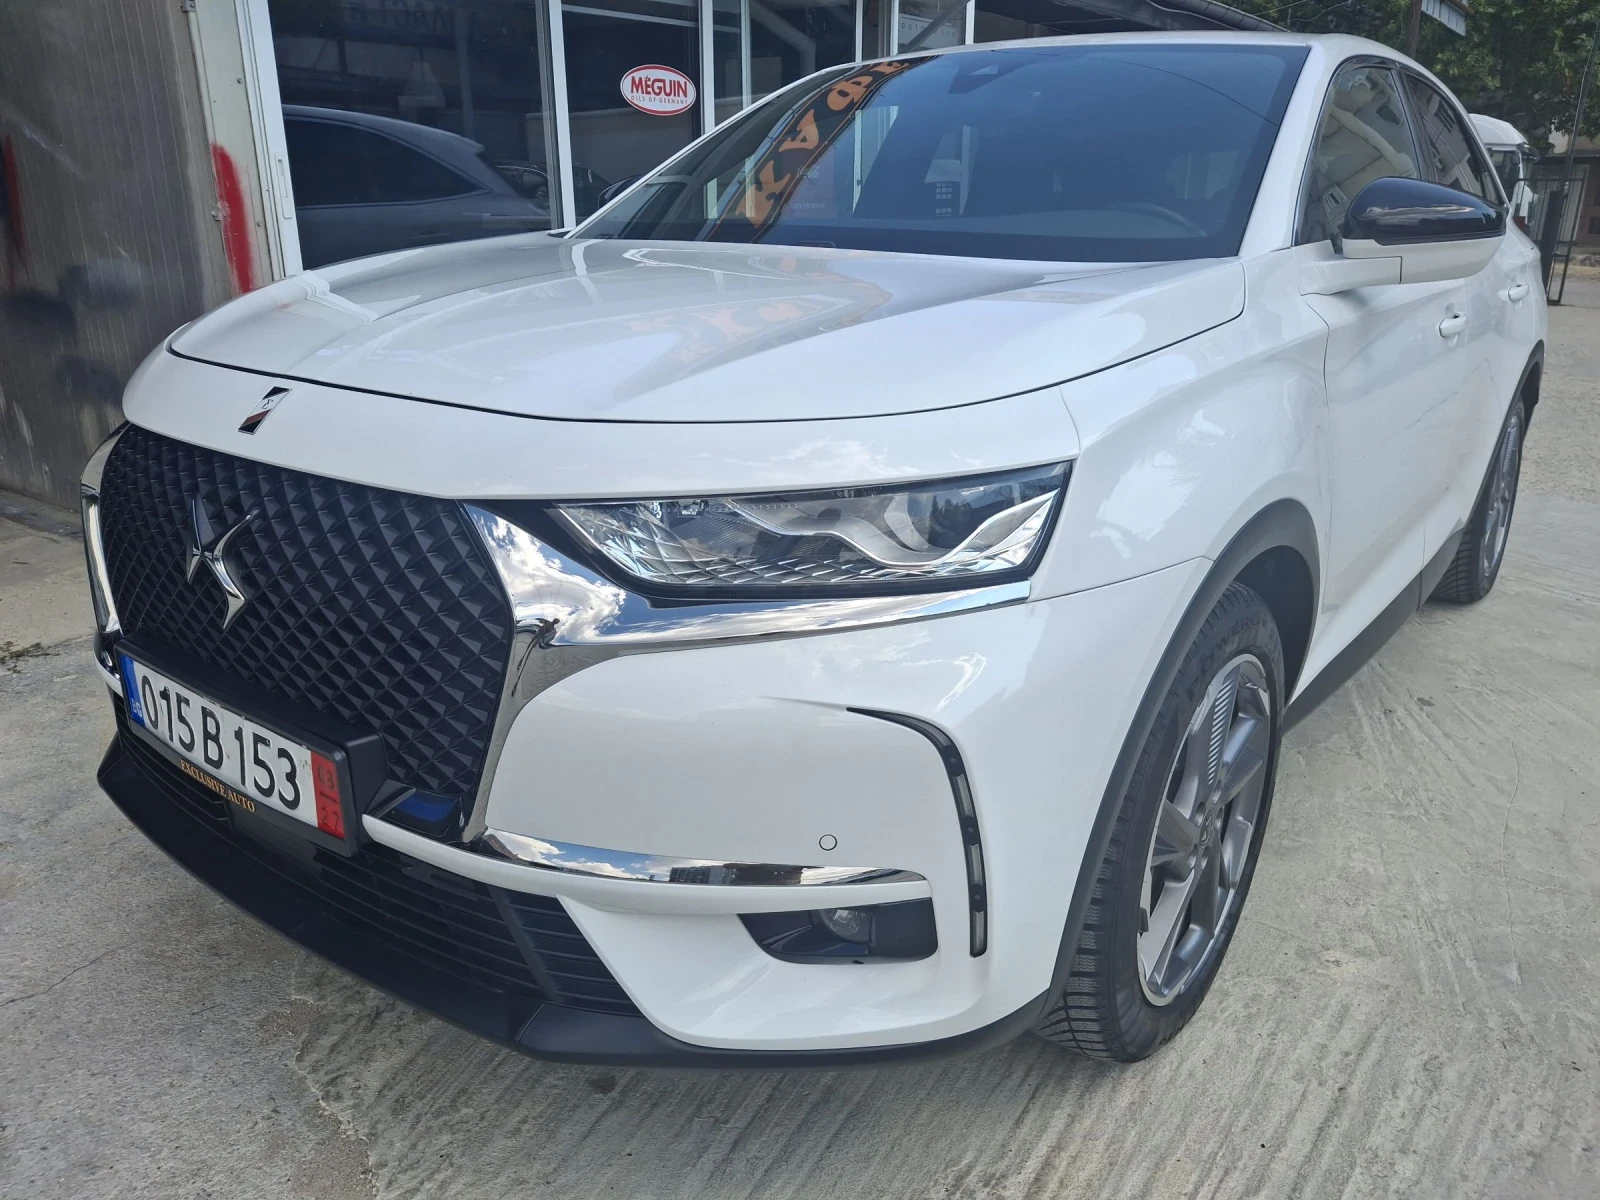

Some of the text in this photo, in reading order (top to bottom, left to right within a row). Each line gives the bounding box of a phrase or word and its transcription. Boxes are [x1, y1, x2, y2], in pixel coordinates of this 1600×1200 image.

[658, 97, 688, 105] GERMANY
[130, 697, 143, 718] BG
[180, 759, 256, 813] EXCLUSIVE AUTO
